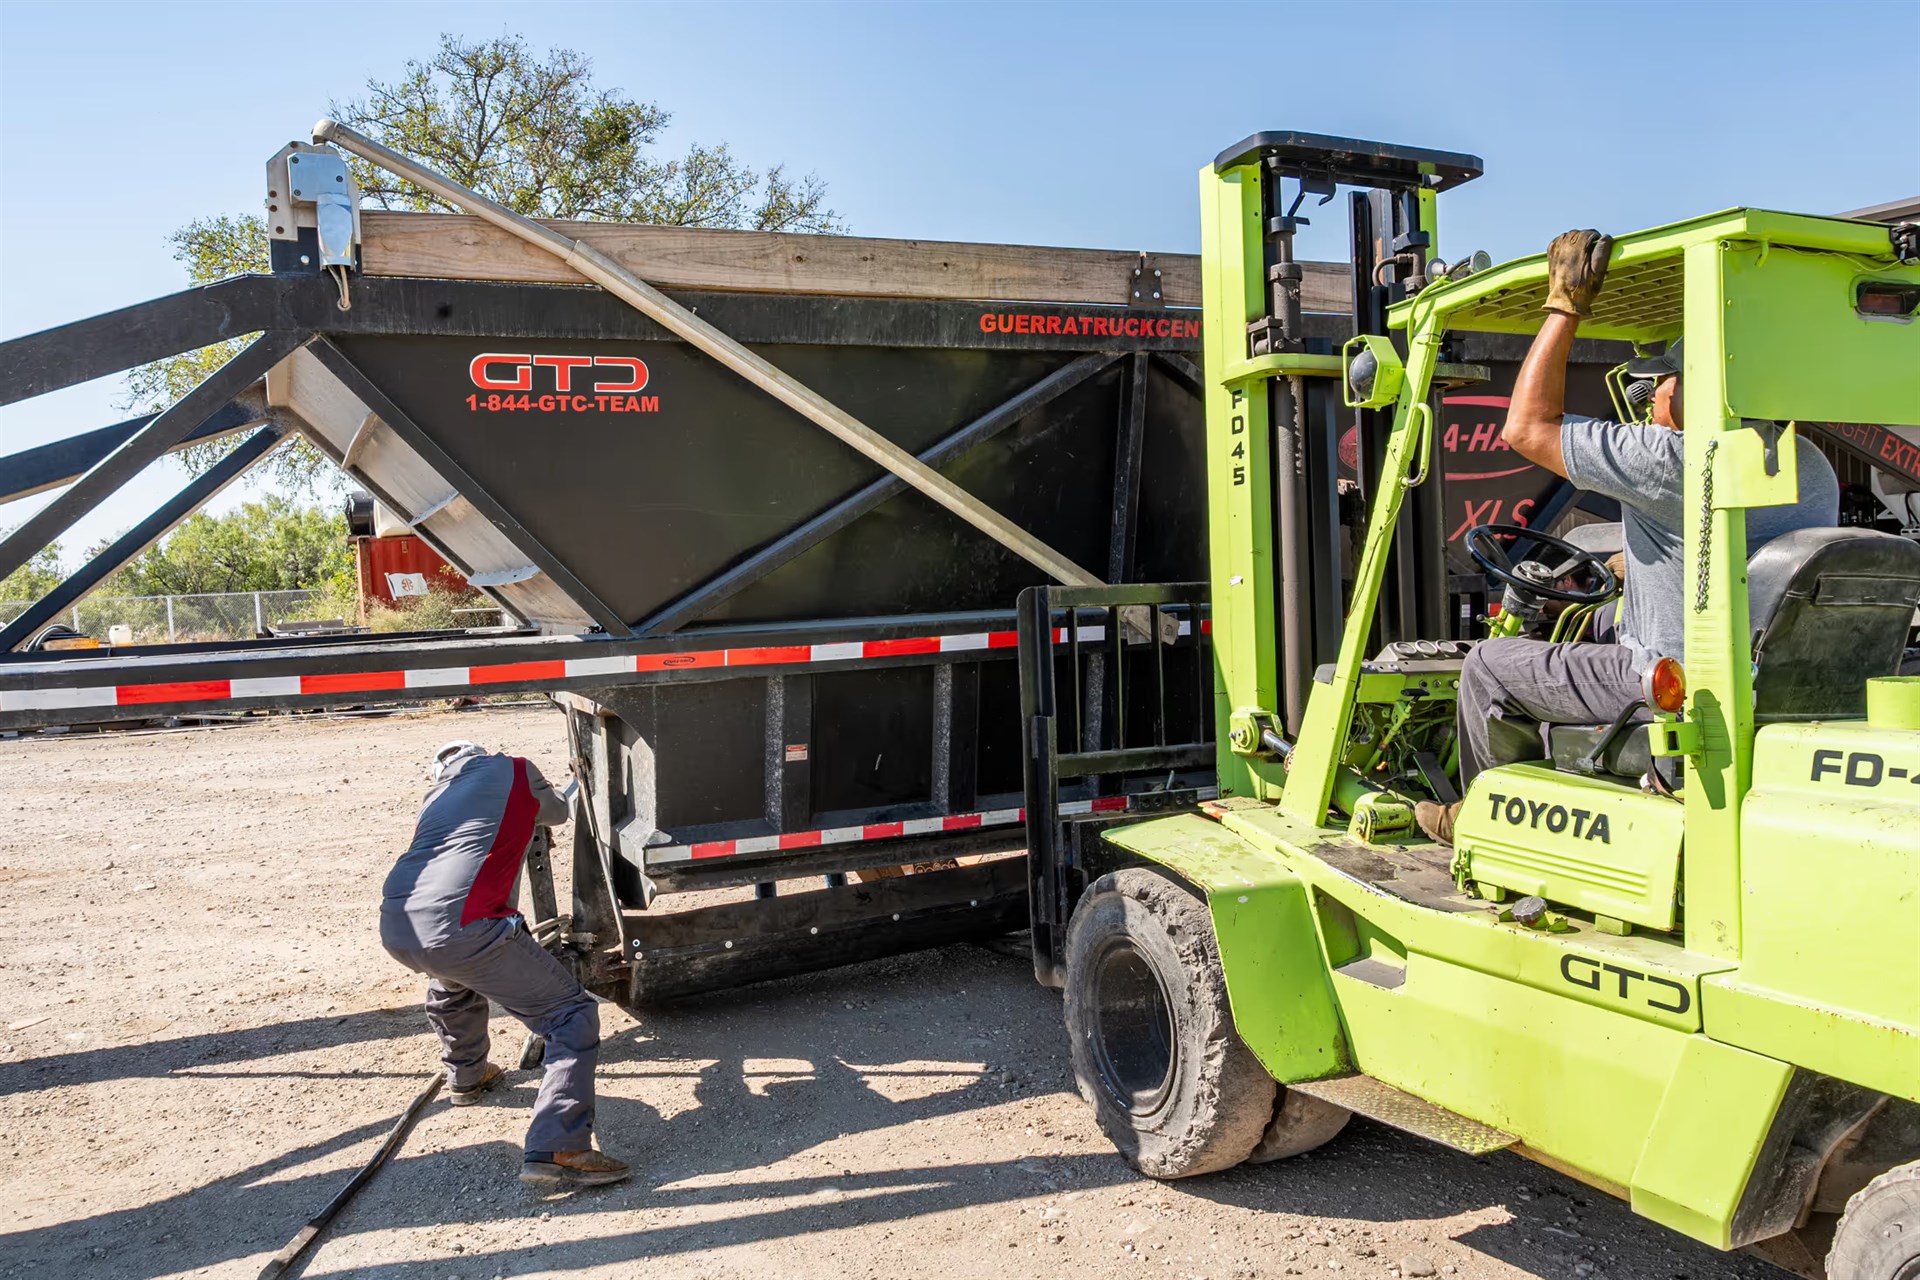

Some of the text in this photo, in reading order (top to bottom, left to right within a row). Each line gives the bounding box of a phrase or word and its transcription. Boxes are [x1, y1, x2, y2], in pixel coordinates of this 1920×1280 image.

[979, 313, 1203, 338] GUERRATRUCKCEN
[466, 394, 660, 413] 1-844-GTC-TEAM
[1231, 389, 1245, 486] FD45
[1447, 498, 1535, 541] XLS
[1489, 793, 1611, 844] TOYOTA
